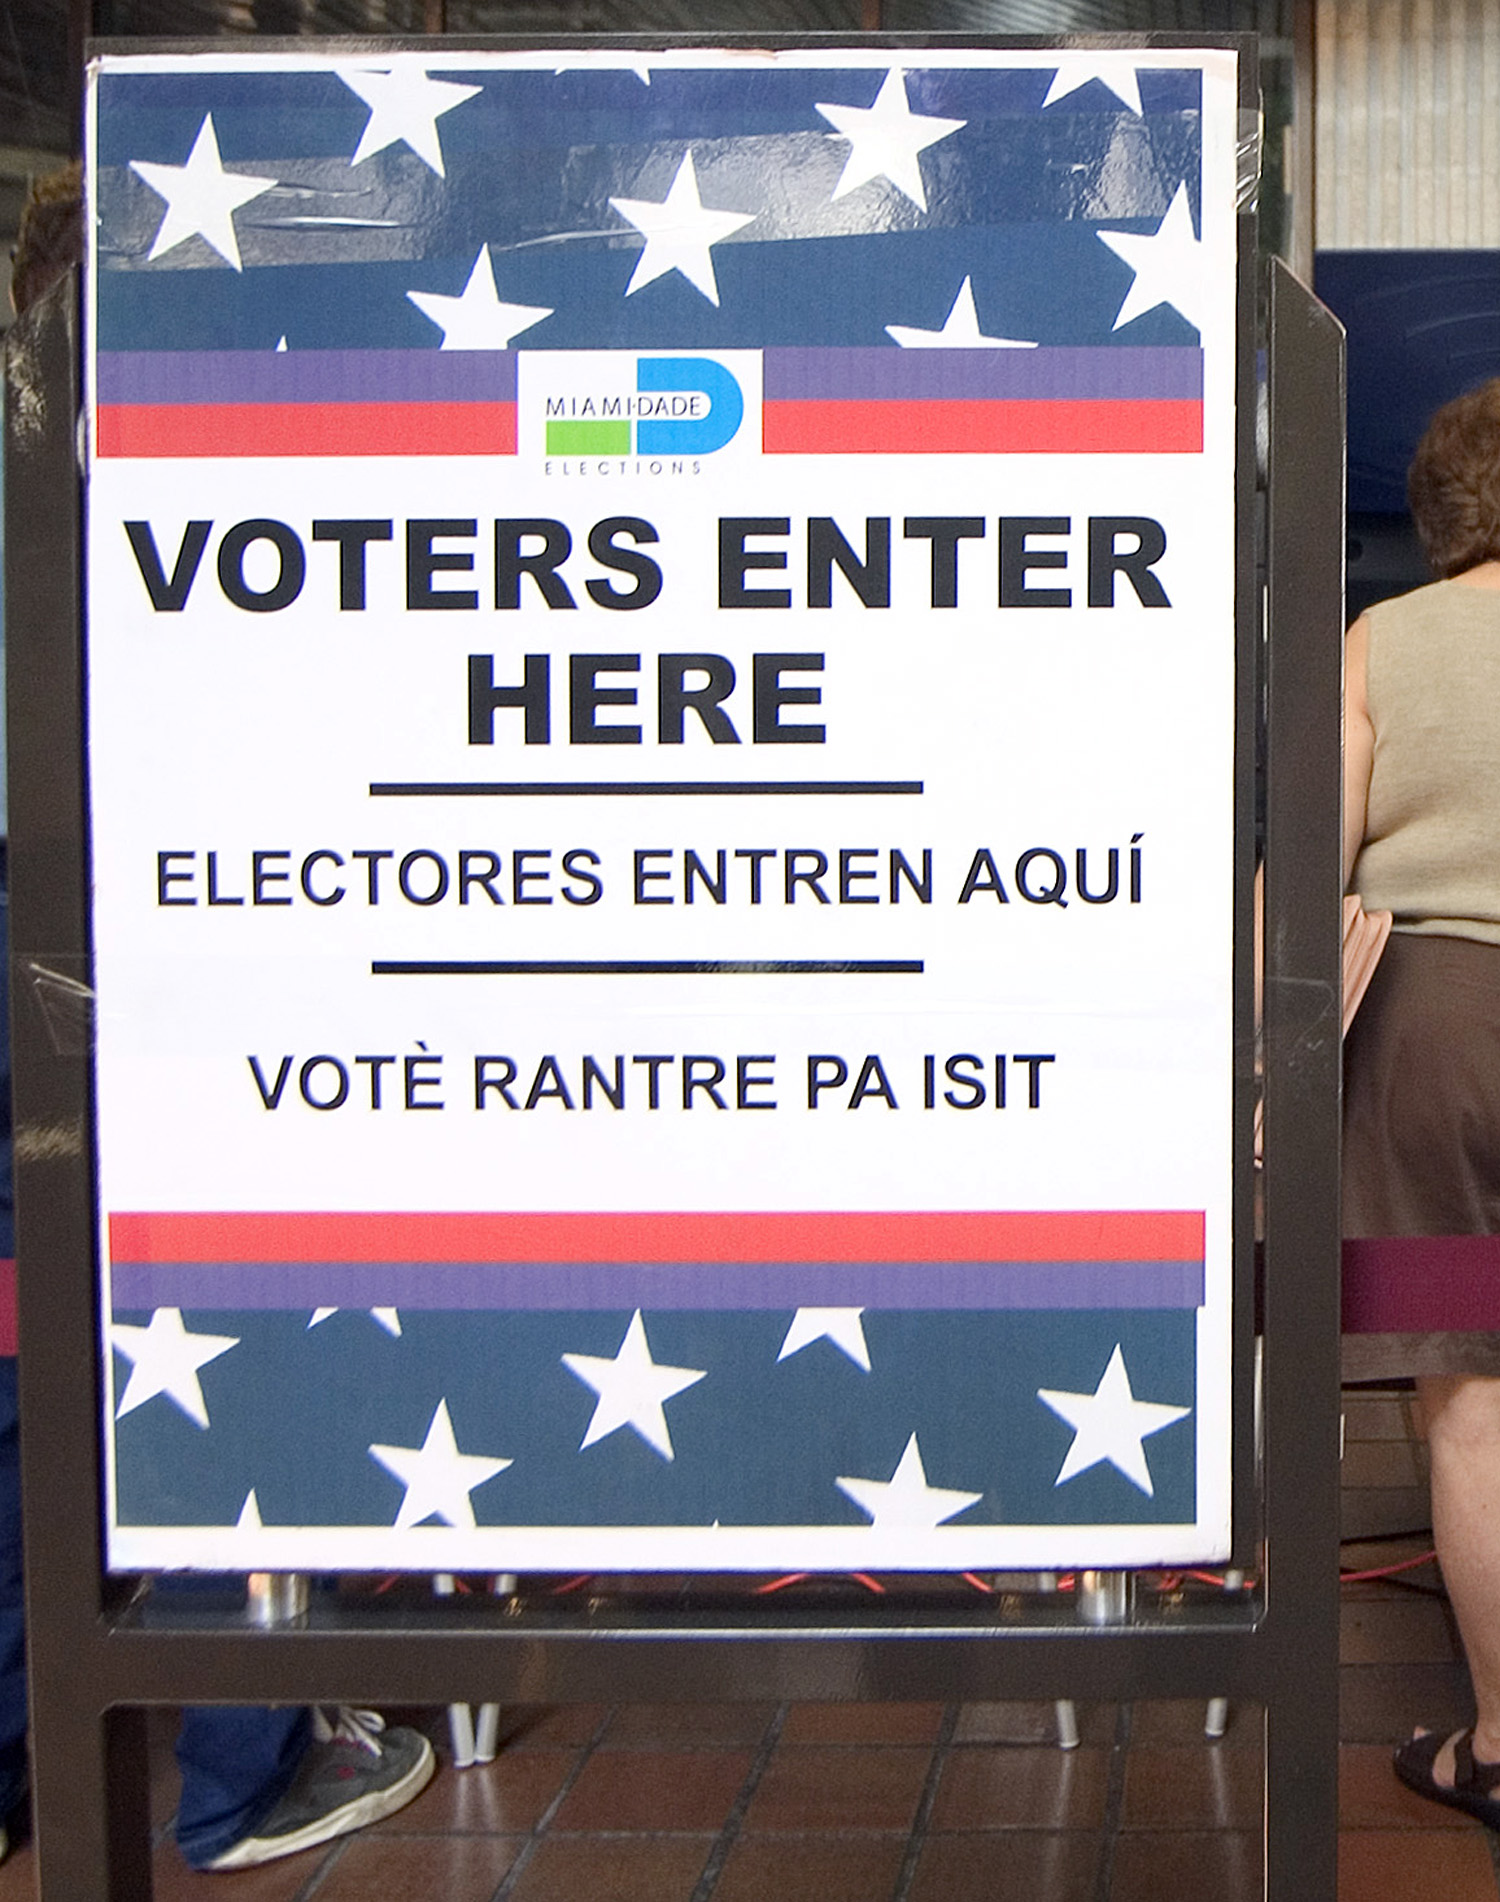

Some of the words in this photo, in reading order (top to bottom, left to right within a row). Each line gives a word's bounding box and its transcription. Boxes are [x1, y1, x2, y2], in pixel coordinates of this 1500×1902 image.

[544, 460, 702, 476] ELECTIONS
[123, 516, 664, 613] VOTERS
[718, 516, 1172, 609] ENTER
[467, 652, 827, 746] HERE
[157, 848, 603, 907] ELECTORES
[633, 848, 933, 905] ENTREN
[957, 832, 1144, 909] AQUÍ
[247, 1041, 444, 1111] VOTÈ
[474, 1055, 777, 1110] RANTRE
[807, 1054, 899, 1110] PA
[924, 1053, 1056, 1110] ISIT
